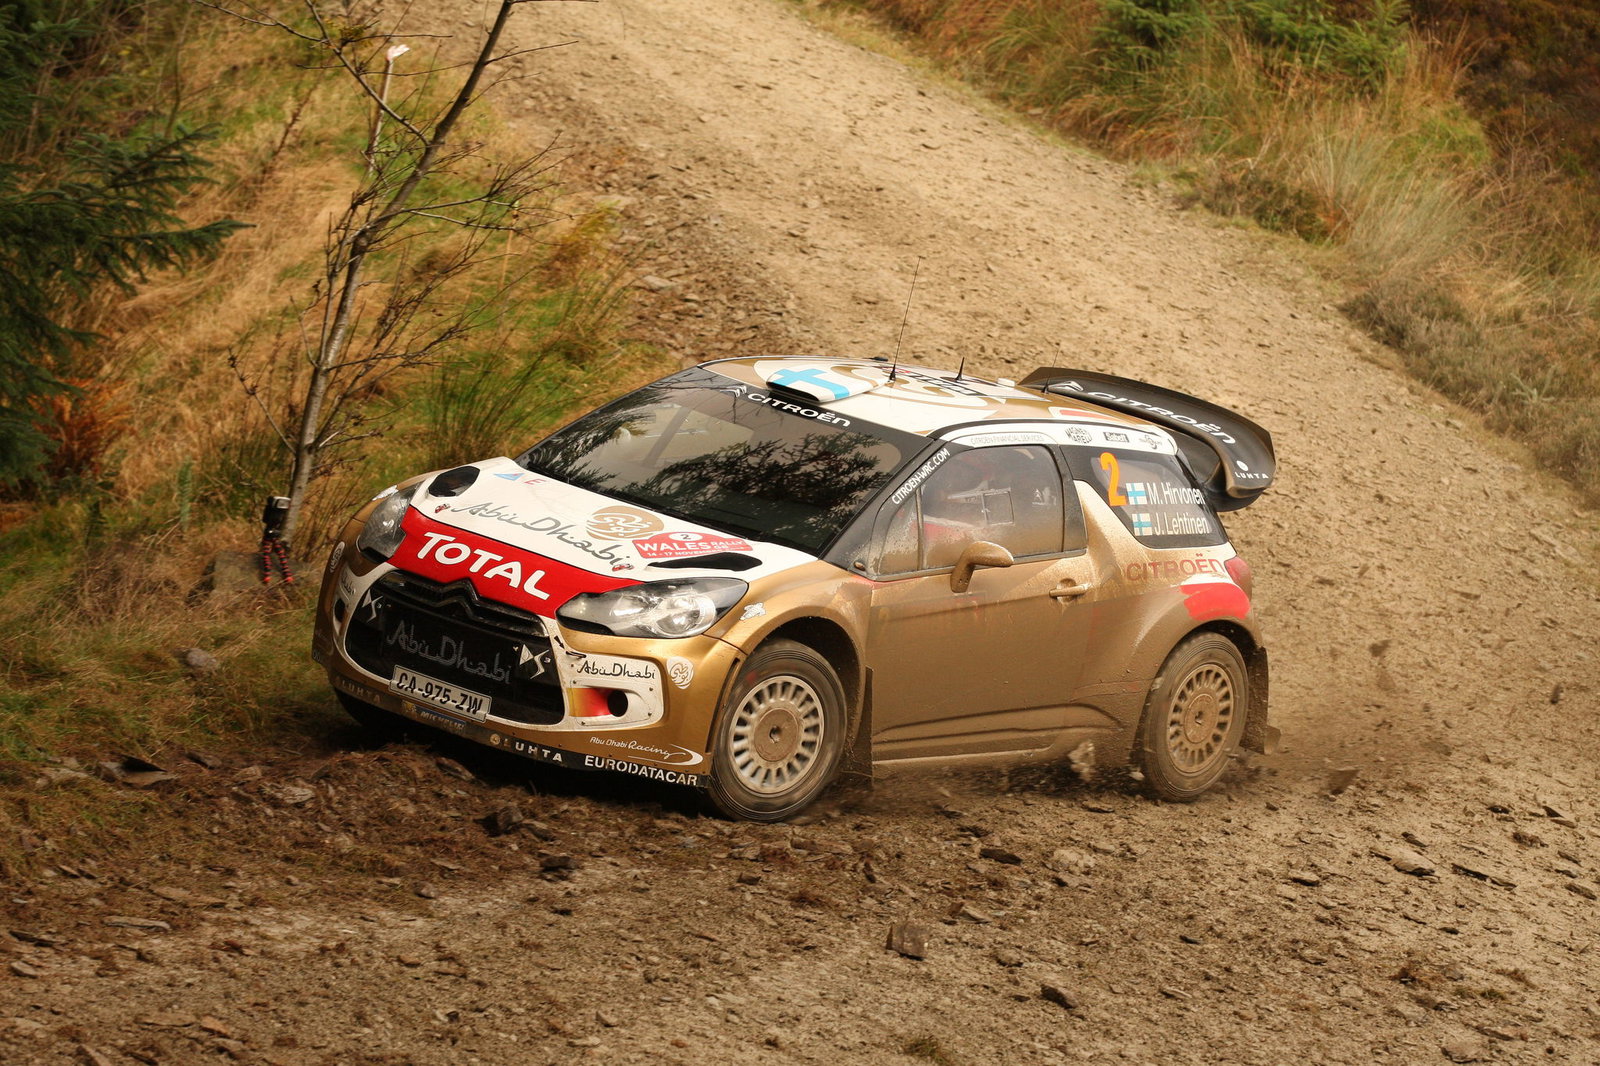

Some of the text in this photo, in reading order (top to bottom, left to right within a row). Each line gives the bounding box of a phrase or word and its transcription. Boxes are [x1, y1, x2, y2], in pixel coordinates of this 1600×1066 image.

[748, 393, 850, 427] CITROËN
[1087, 391, 1236, 444] CITROËN
[891, 448, 950, 504] CITROEN-WRC.COM
[1100, 452, 1128, 506] 2
[1234, 471, 1269, 479] LUHTA
[1147, 482, 1206, 505] M. Hirvonen
[1154, 512, 1210, 536] J. Lehtinen
[636, 541, 709, 552] WALES
[416, 531, 550, 601] TOTAL
[1126, 553, 1227, 581] CITROËN
[397, 672, 483, 715] CA-975-ZW
[589, 736, 675, 760] Abu Dhabi Racing
[584, 755, 699, 787] EURODATACAR
